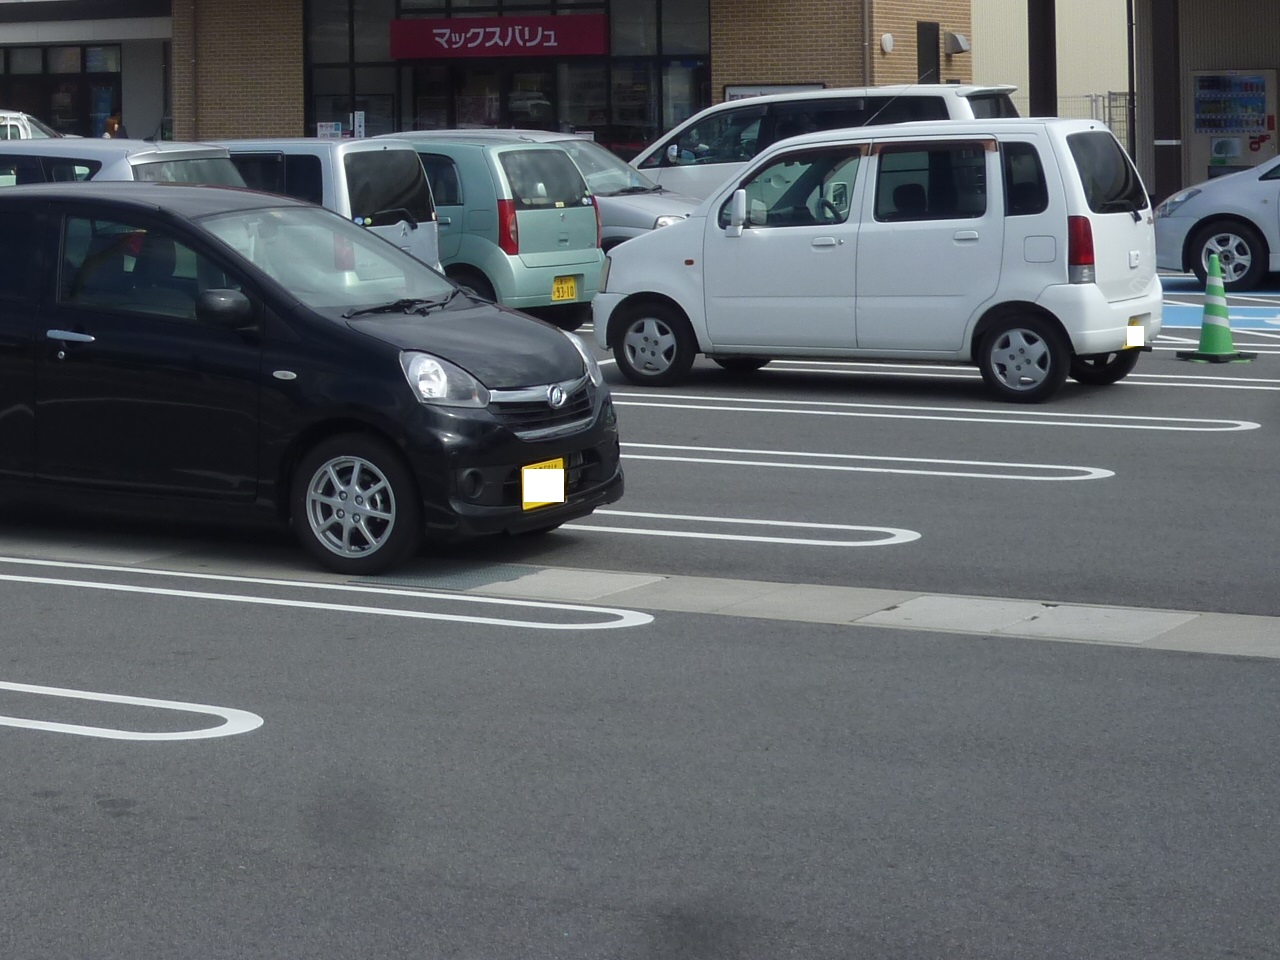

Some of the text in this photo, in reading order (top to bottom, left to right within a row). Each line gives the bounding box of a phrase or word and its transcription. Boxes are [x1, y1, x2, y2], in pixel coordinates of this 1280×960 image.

[432, 25, 559, 49] マックスバリュ
